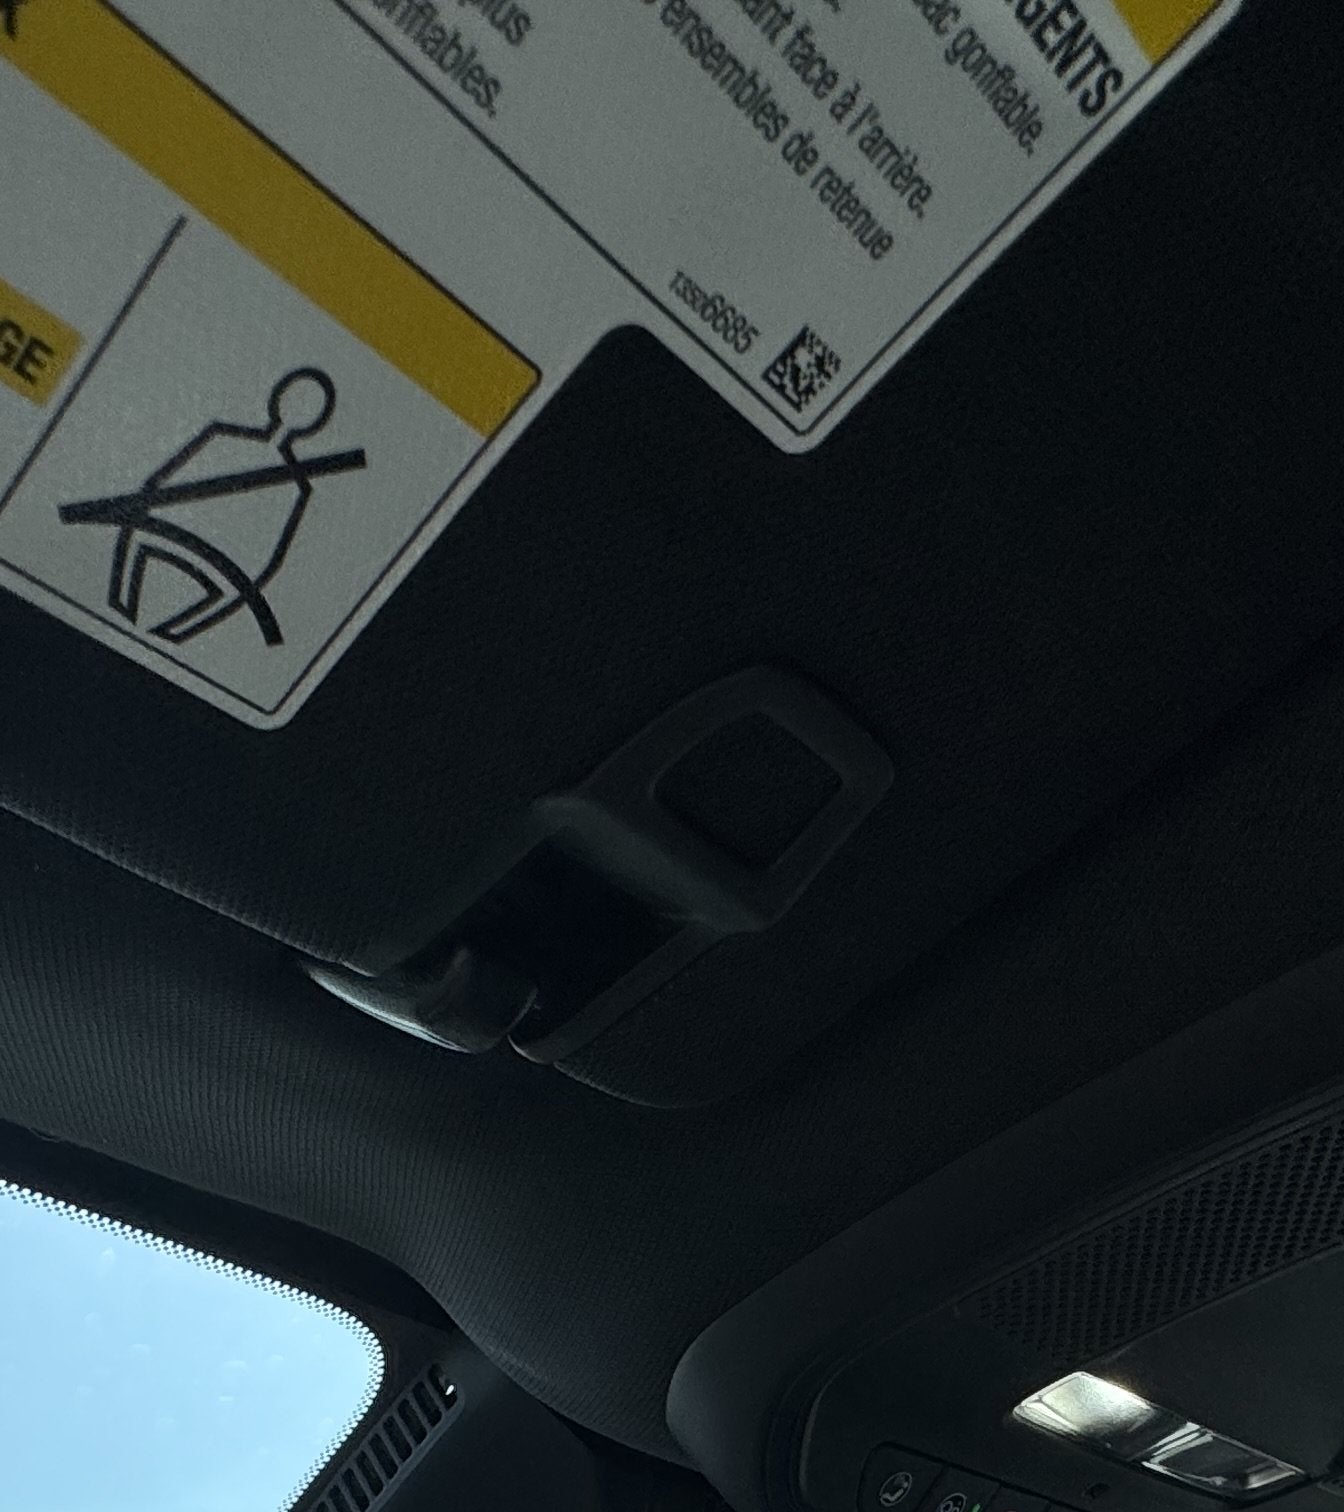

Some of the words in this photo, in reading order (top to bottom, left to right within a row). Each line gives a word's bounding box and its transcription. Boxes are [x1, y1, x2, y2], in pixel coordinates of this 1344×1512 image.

[781, 26, 839, 101] face
[828, 80, 862, 125] à
[944, 26, 1044, 158] gonflable.
[1007, 0, 1125, 119] GENTS
[660, 0, 789, 143] ensembles
[782, 130, 818, 177] de
[811, 162, 893, 260] retenue
